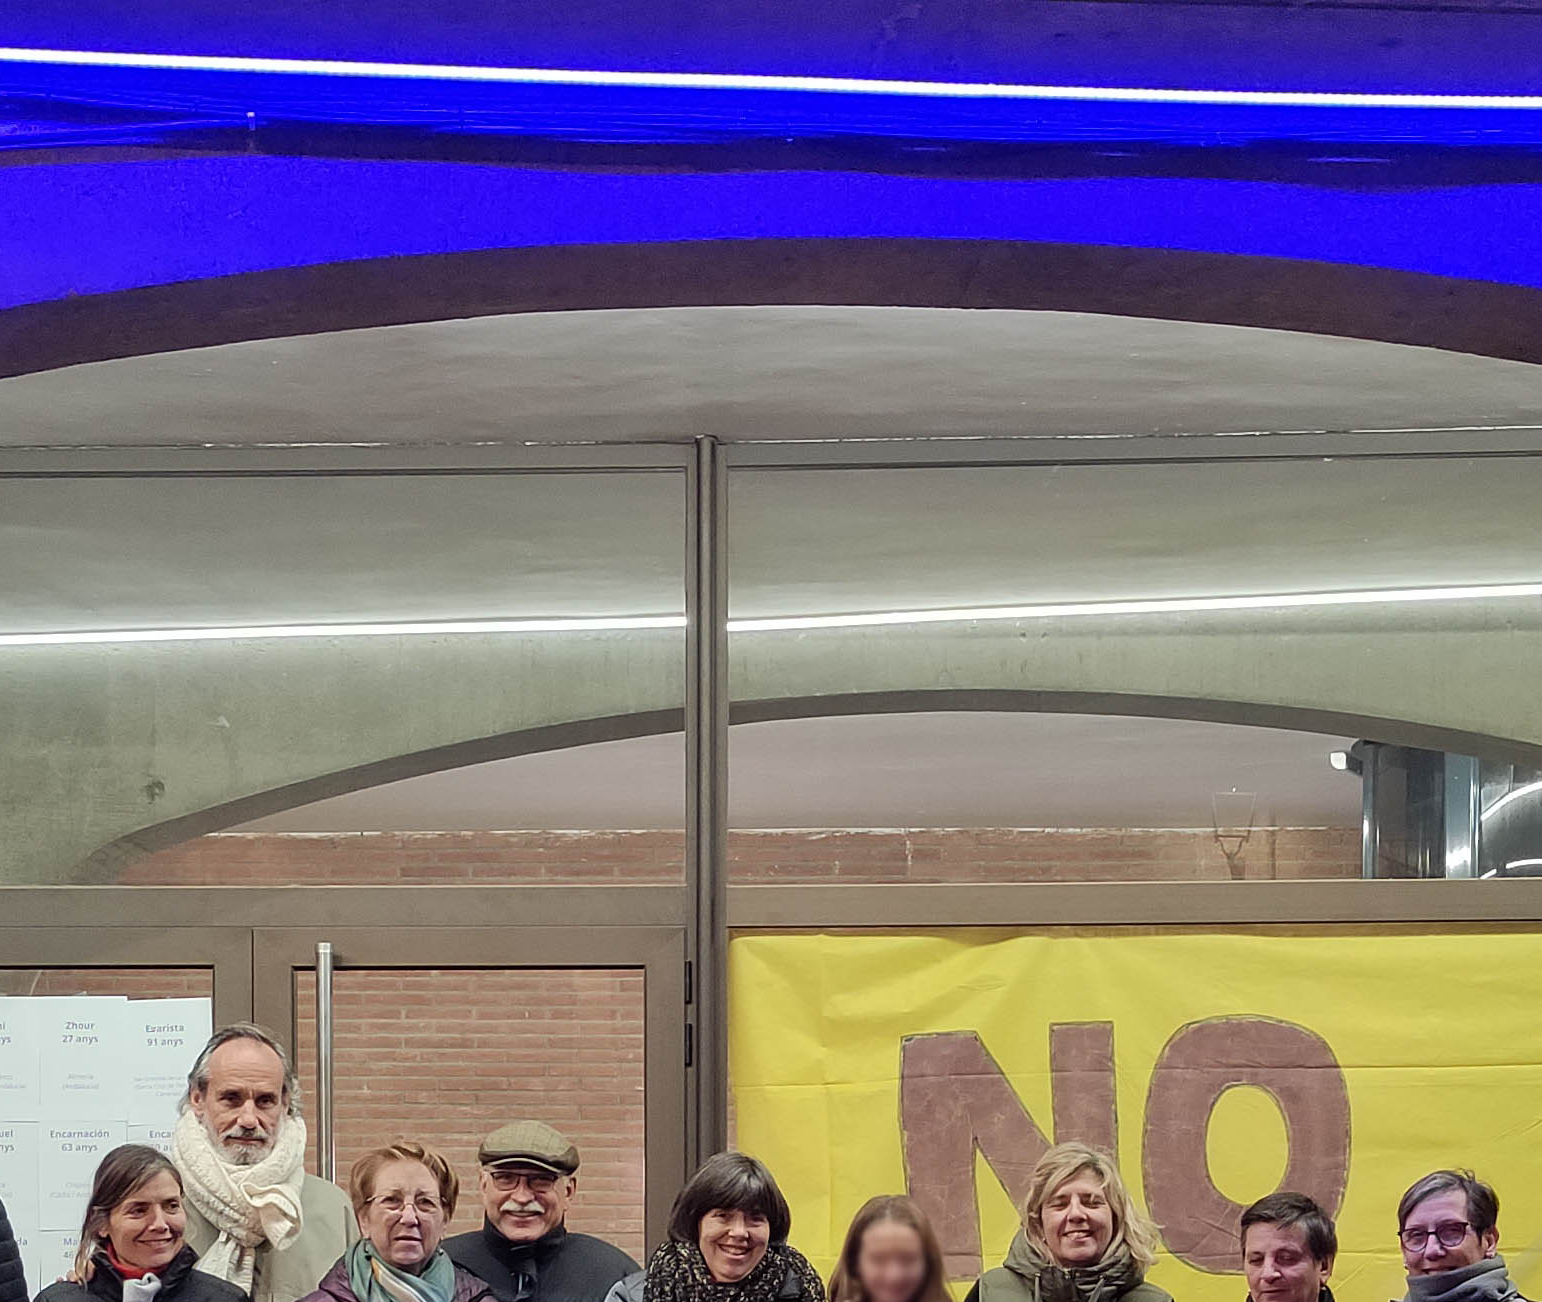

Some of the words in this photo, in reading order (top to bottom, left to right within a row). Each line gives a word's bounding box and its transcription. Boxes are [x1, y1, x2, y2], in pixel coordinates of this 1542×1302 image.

[64, 1020, 96, 1031] Zhour
[145, 1022, 186, 1034] Evarista
[62, 1034, 74, 1045] 27
[75, 1035, 100, 1046] anys
[146, 1037, 158, 1048] 91
[160, 1036, 185, 1047] anys
[49, 1127, 111, 1139] Encarnación
[149, 1129, 175, 1139] Enca
[61, 1142, 74, 1153] 63
[75, 1143, 99, 1154] anys
[899, 1013, 1352, 1283] NO
